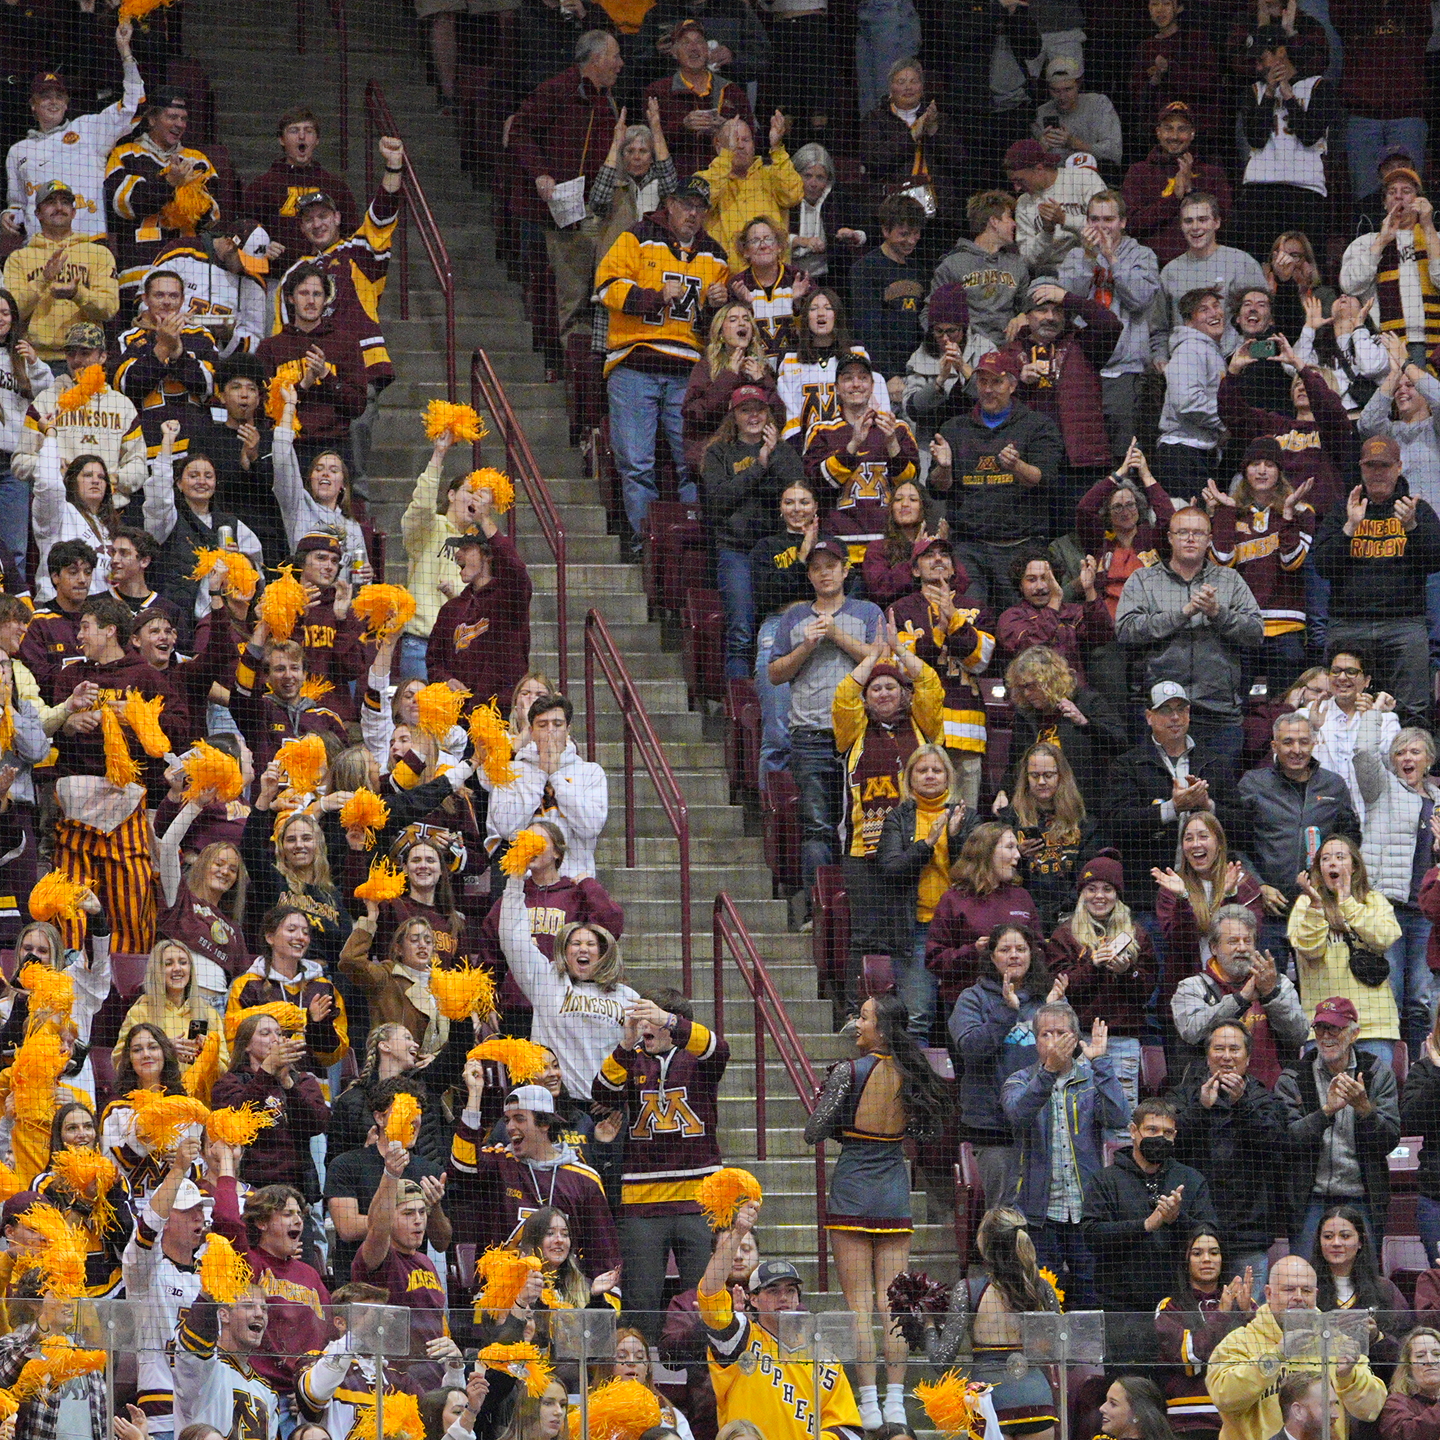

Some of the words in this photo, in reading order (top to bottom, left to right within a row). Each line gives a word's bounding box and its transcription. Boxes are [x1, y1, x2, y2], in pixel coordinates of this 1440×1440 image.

[840, 461, 892, 508] M
[1351, 538, 1407, 557] RUGBY
[863, 774, 901, 802] M
[630, 1087, 706, 1139] M
